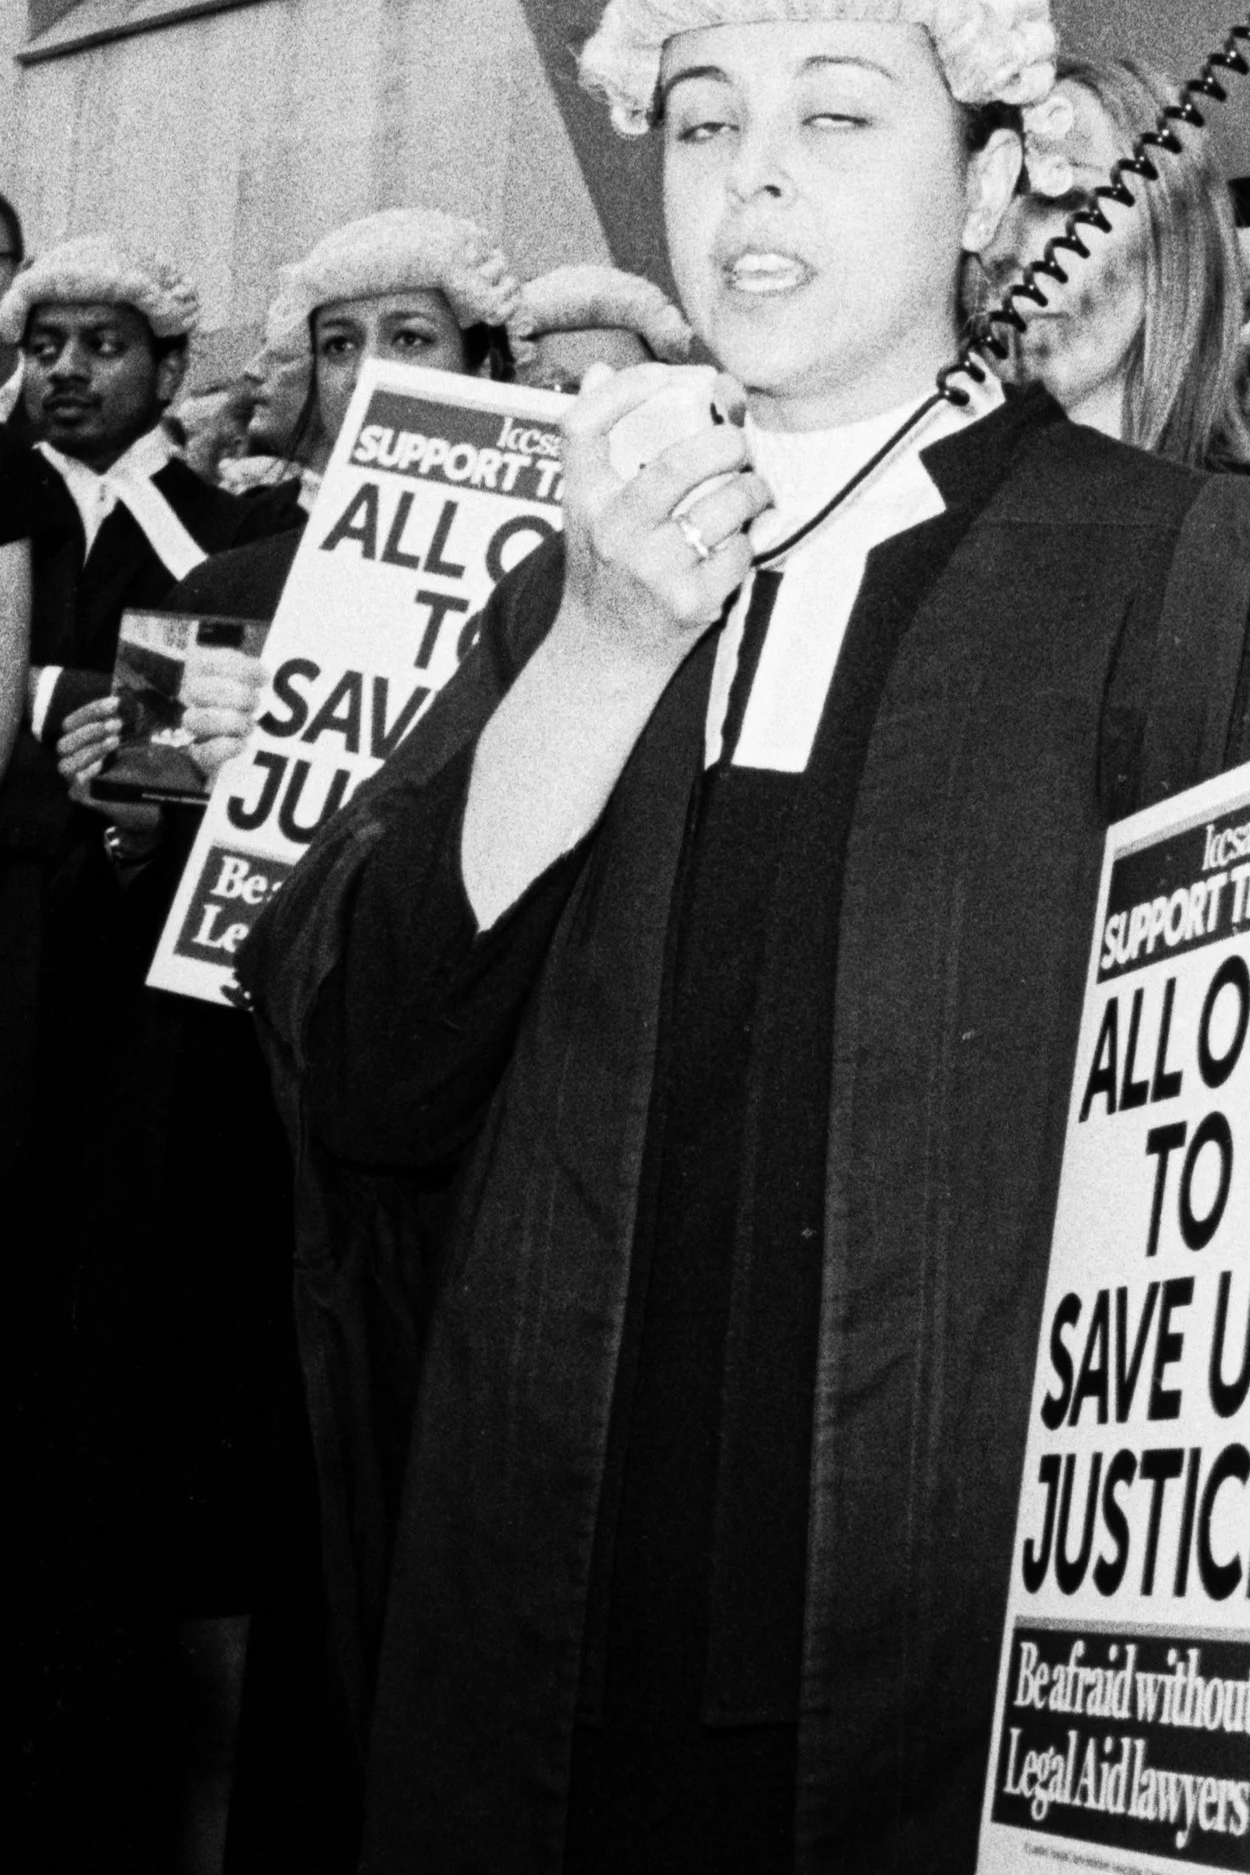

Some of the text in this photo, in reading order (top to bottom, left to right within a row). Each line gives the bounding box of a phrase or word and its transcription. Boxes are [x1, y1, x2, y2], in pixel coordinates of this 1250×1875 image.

[355, 424, 530, 492] SUPPORT
[319, 482, 466, 579] ALL
[1101, 873, 1229, 970] SUPPORT
[1079, 977, 1183, 1124] ALL
[1145, 1111, 1234, 1257] TO
[1040, 1276, 1195, 1431] SAVE
[1013, 1641, 1048, 1708] Be
[1047, 1640, 1137, 1720] afraid
[1003, 1727, 1074, 1820] Legal
[1073, 1730, 1132, 1812] Aid
